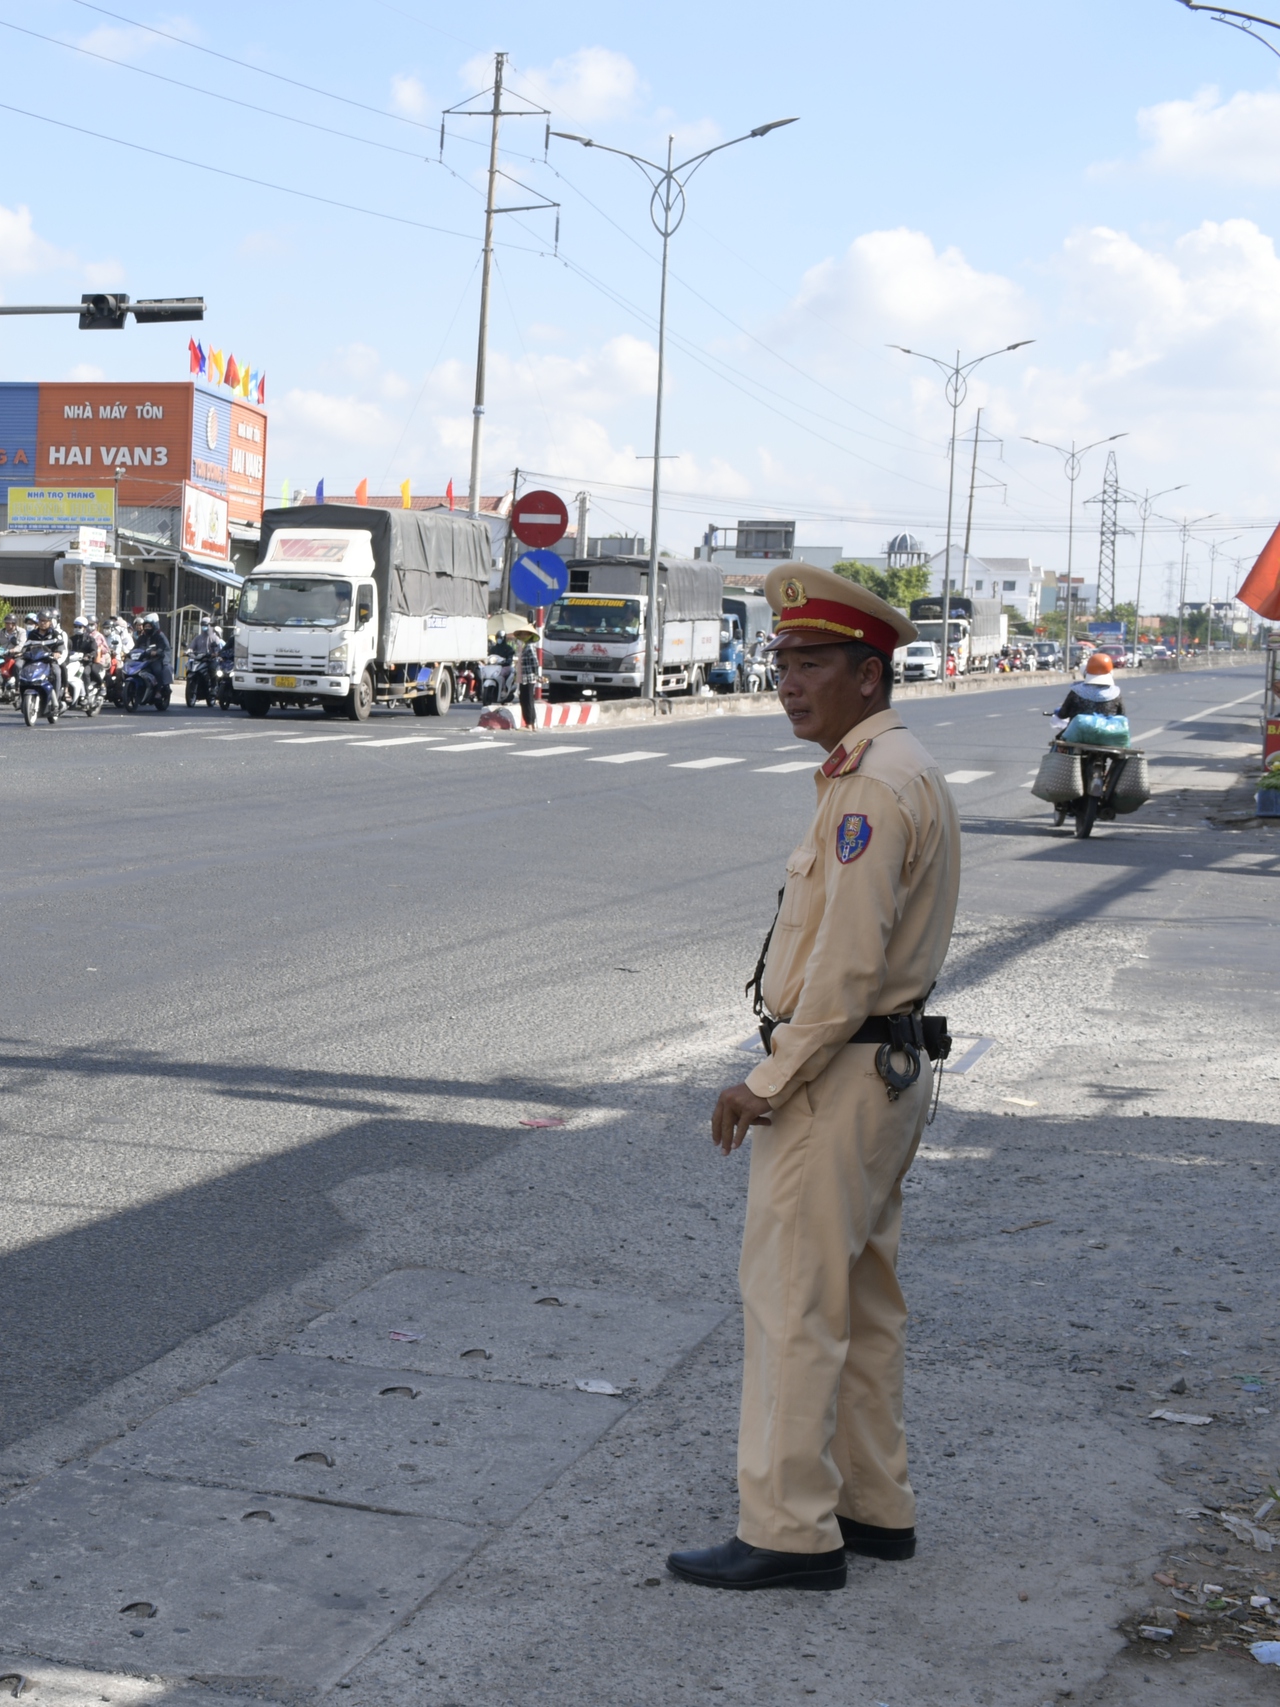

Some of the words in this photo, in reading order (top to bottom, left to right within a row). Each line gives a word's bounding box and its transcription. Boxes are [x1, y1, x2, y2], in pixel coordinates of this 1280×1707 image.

[63, 401, 93, 419] NHÀ
[99, 401, 128, 419] MÁY
[135, 402, 163, 420] TÔN
[48, 445, 93, 466] HAI
